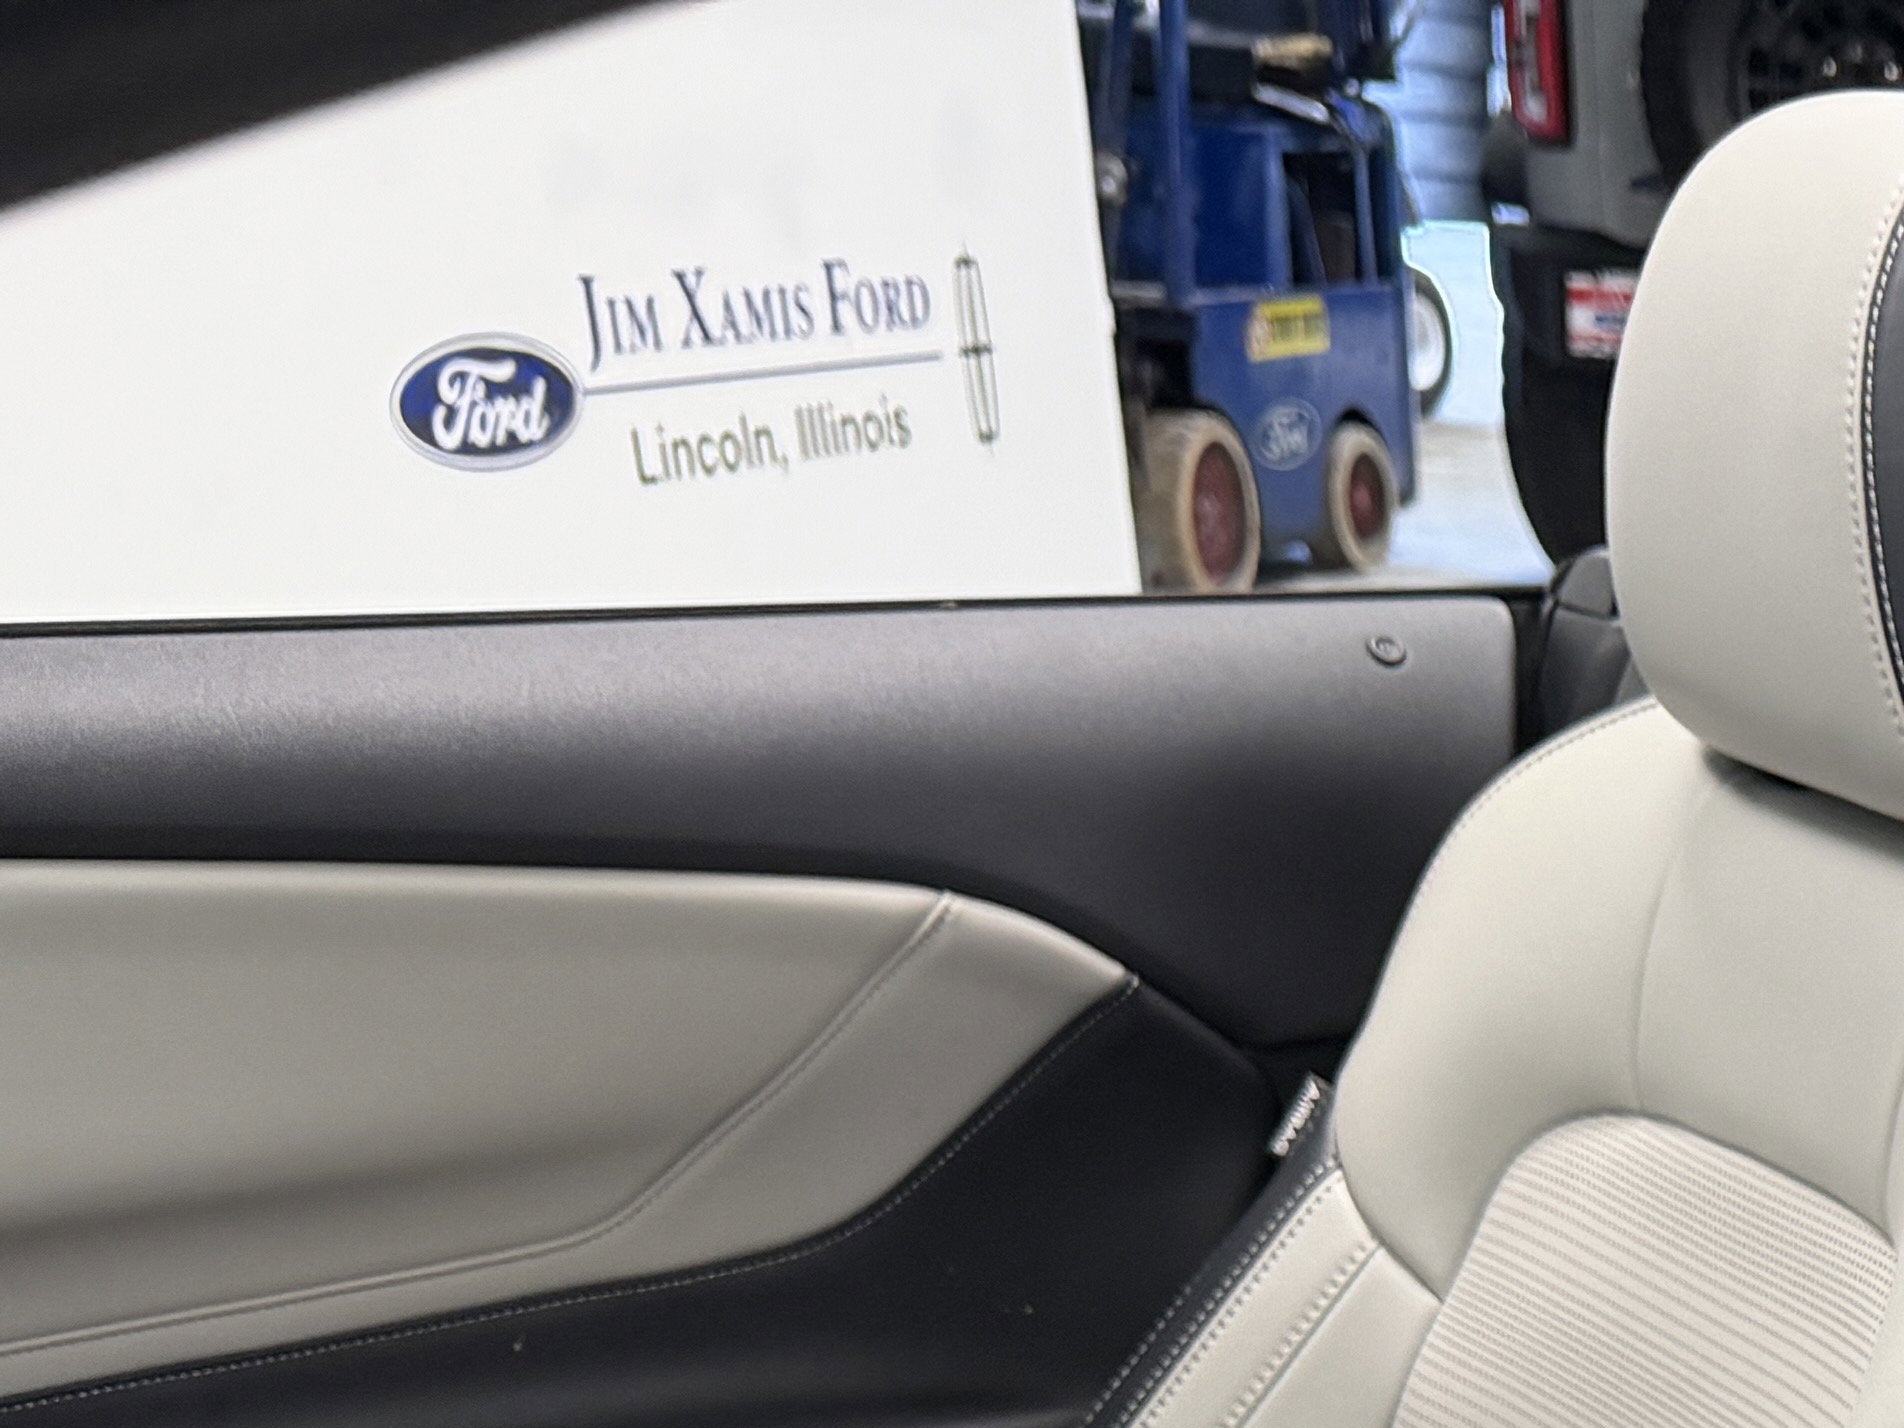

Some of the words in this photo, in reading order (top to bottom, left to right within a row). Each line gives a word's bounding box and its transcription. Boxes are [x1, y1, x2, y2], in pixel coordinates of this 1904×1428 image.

[578, 272, 663, 373] JIM
[671, 264, 817, 352] XAMIS
[821, 256, 933, 339] FORD
[431, 355, 551, 452] Ford
[630, 408, 789, 487] Lincoln,
[793, 392, 913, 464] Illinois
